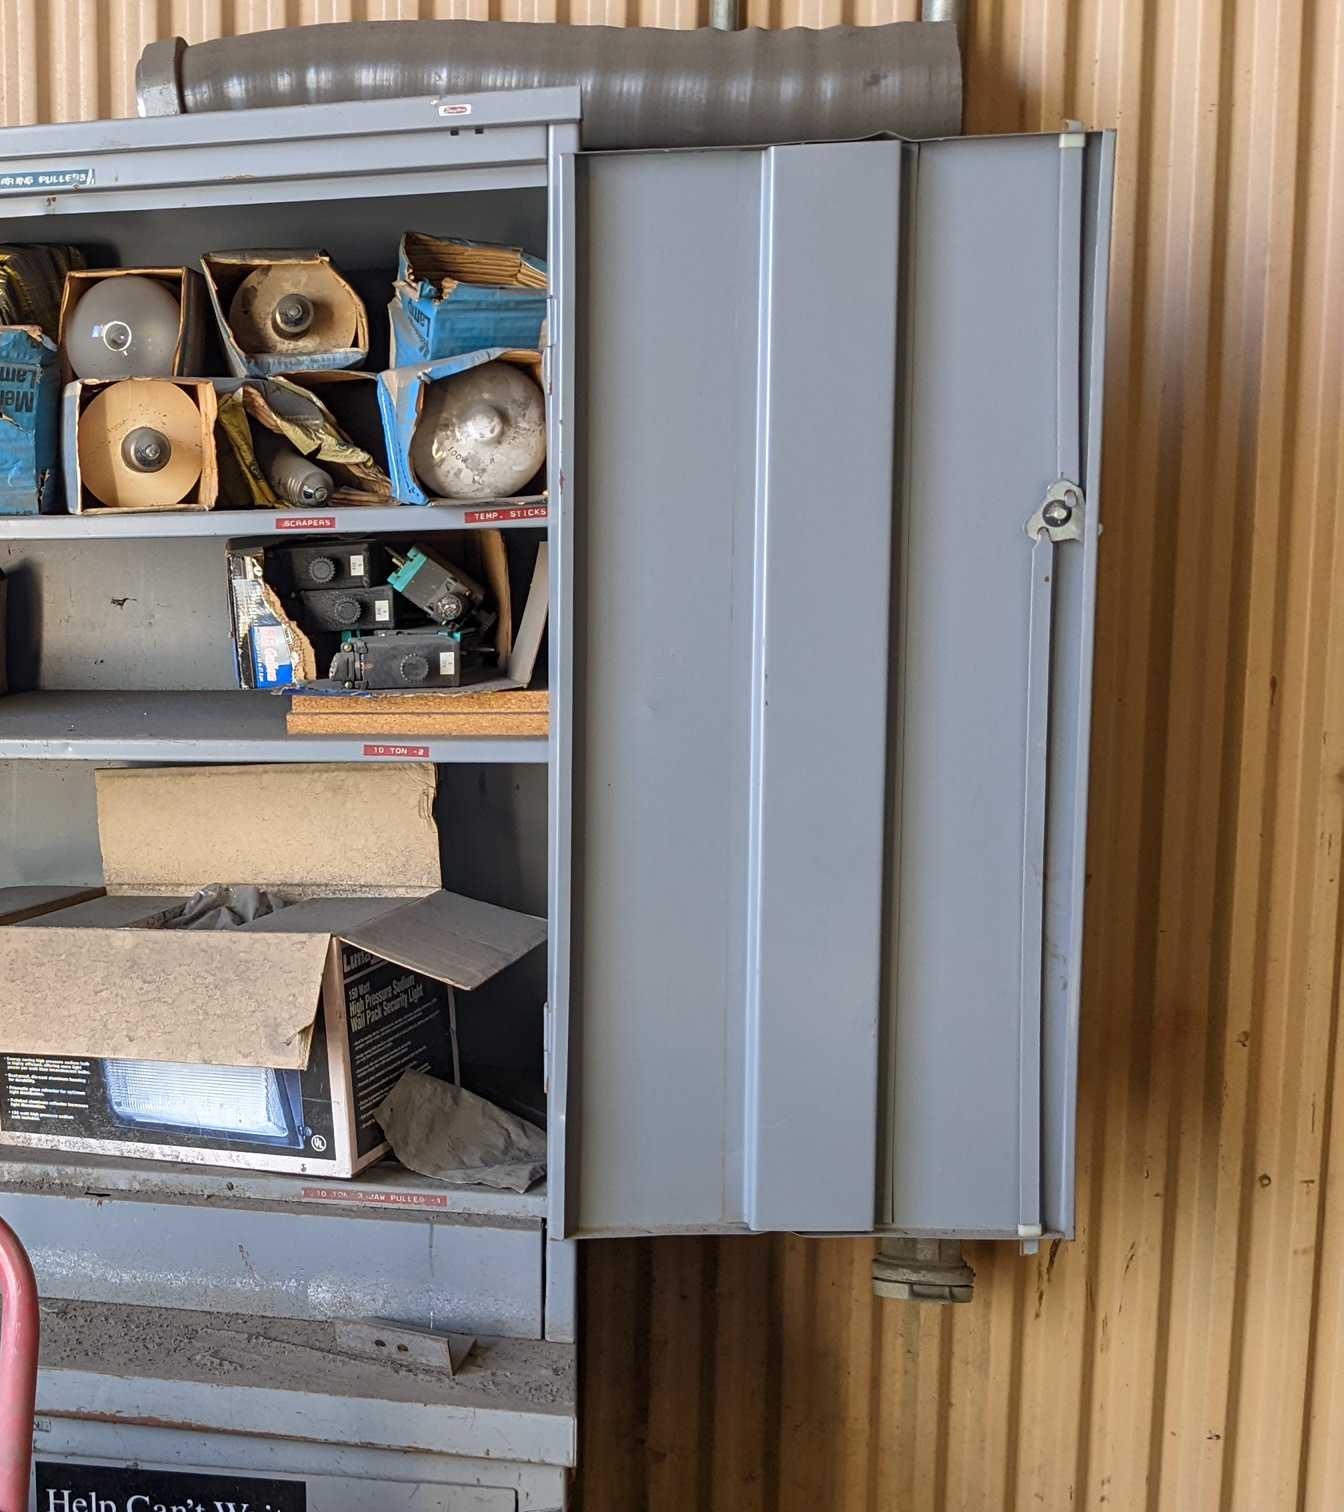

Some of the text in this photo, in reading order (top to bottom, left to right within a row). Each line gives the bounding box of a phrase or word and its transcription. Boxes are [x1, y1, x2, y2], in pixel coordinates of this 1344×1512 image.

[284, 519, 331, 528] SCRAPERS
[475, 507, 546, 521] TEMP. STICKS
[374, 746, 384, 754] 10
[350, 974, 415, 1017] High Pressure Sodium
[351, 983, 424, 1033] Wall Pack Security Light
[46, 1488, 115, 1512] Help
